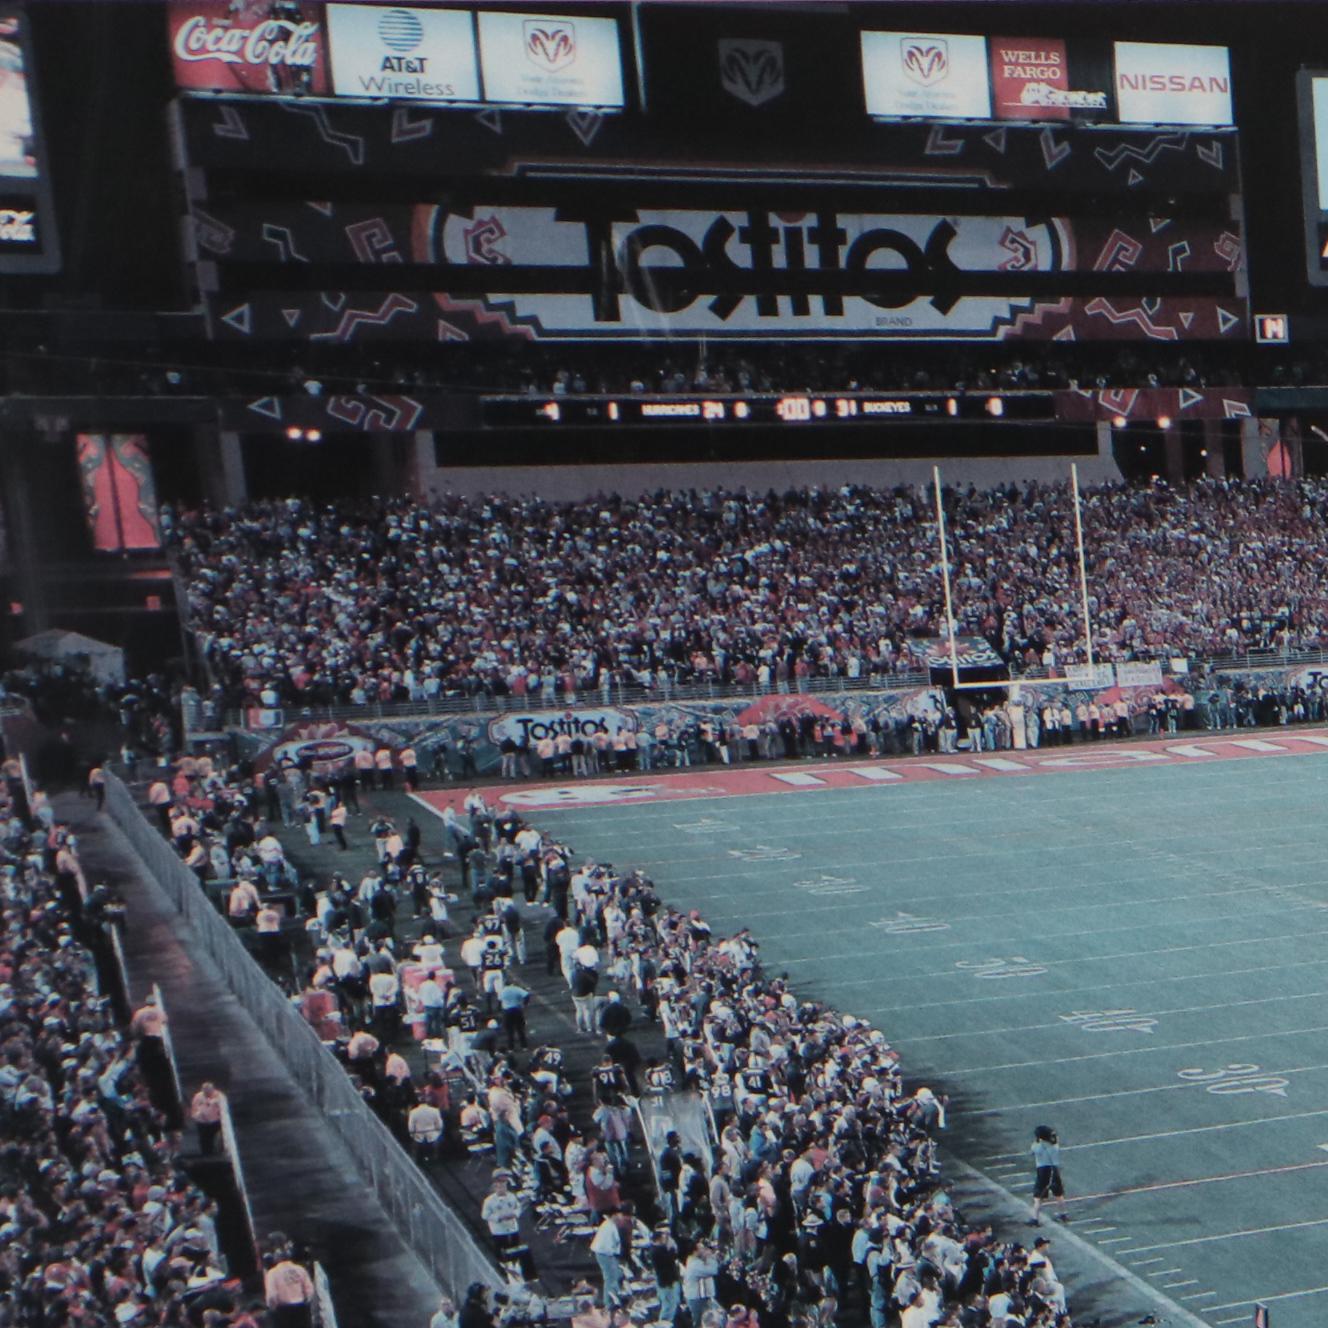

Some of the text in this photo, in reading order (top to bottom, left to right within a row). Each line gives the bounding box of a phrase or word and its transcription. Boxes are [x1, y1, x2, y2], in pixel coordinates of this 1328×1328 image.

[174, 16, 320, 65] Coca-Cola
[381, 56, 428, 73] AT&T
[1001, 50, 1061, 64] WELLS
[1002, 65, 1061, 79] FARGO
[359, 75, 456, 97] Wireless
[1119, 73, 1229, 93] NISSAN
[555, 208, 958, 322] Tostitos
[875, 316, 913, 327] BRAND
[1176, 1062, 1285, 1097] 30
